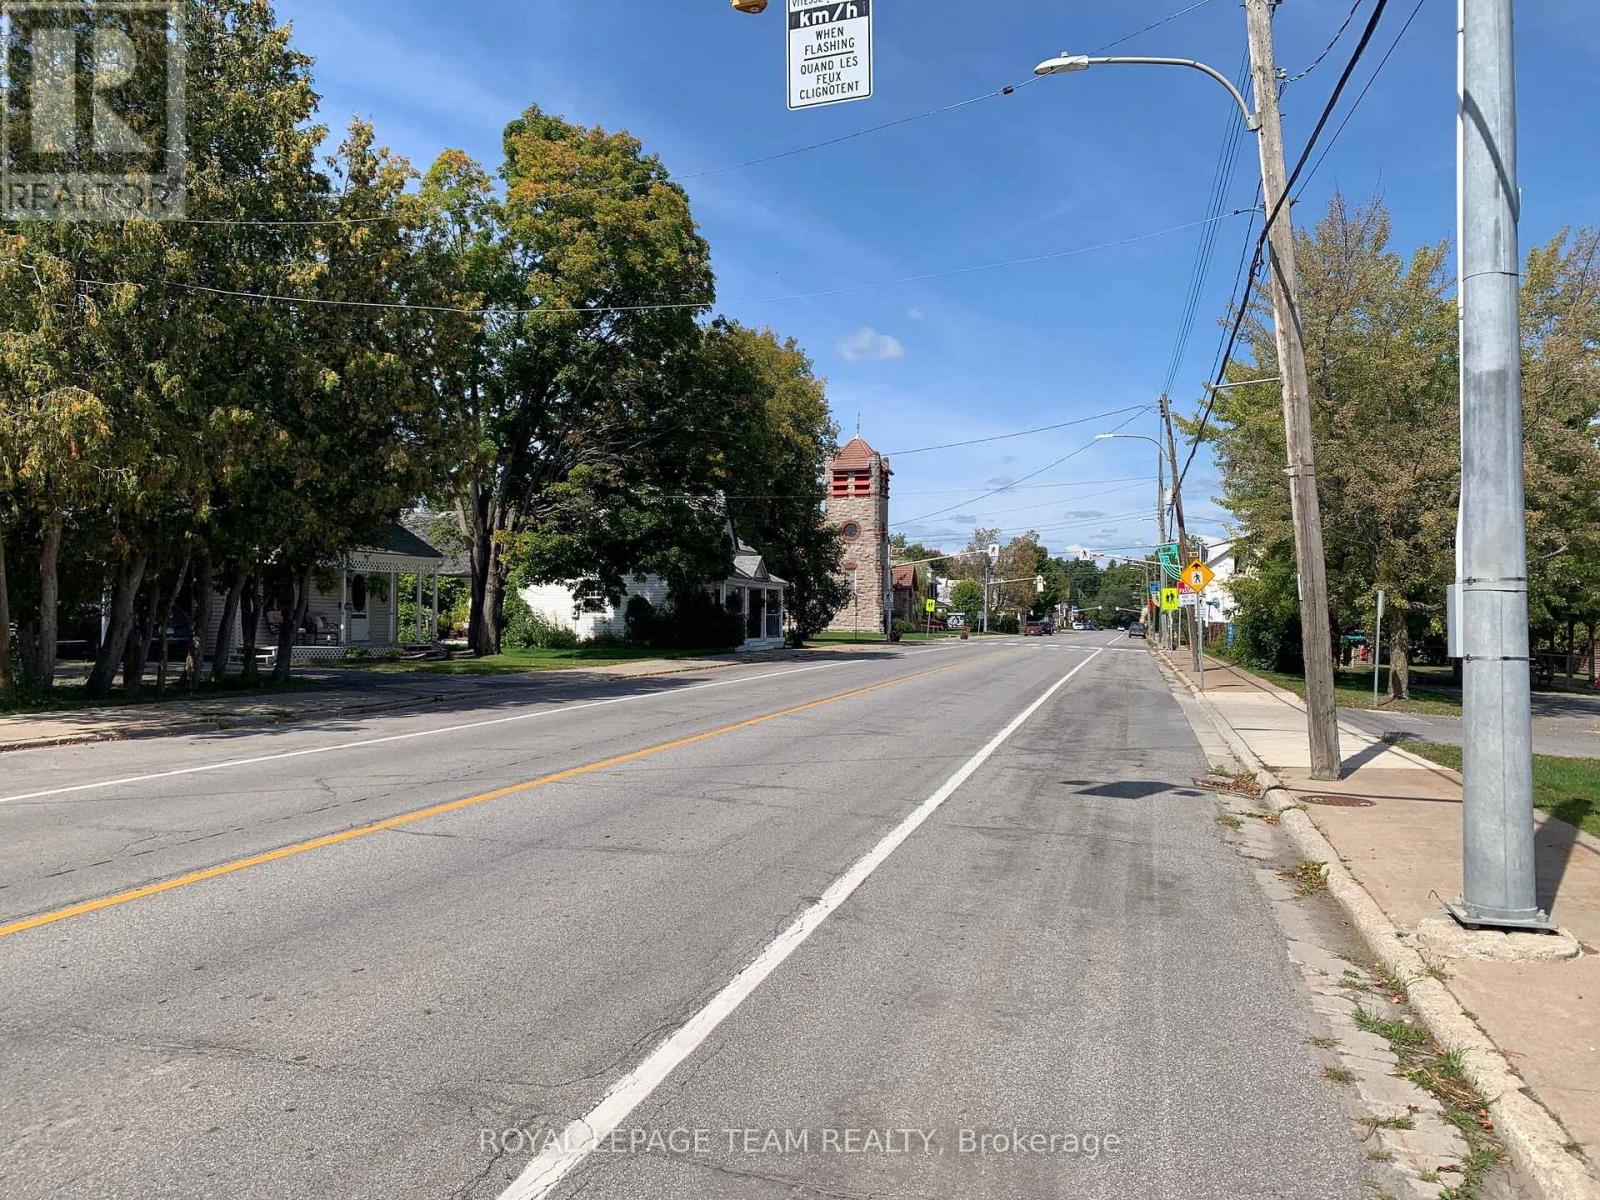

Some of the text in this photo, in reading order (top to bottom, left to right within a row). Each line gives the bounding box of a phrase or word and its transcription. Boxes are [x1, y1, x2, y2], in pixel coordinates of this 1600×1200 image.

[799, 2, 858, 27] km/h
[815, 27, 844, 40] WHEN
[804, 37, 855, 55] FLASHING
[800, 56, 858, 75] QUAND LES
[816, 71, 841, 85] FEUX
[799, 81, 860, 100] CLIGNOTENT
